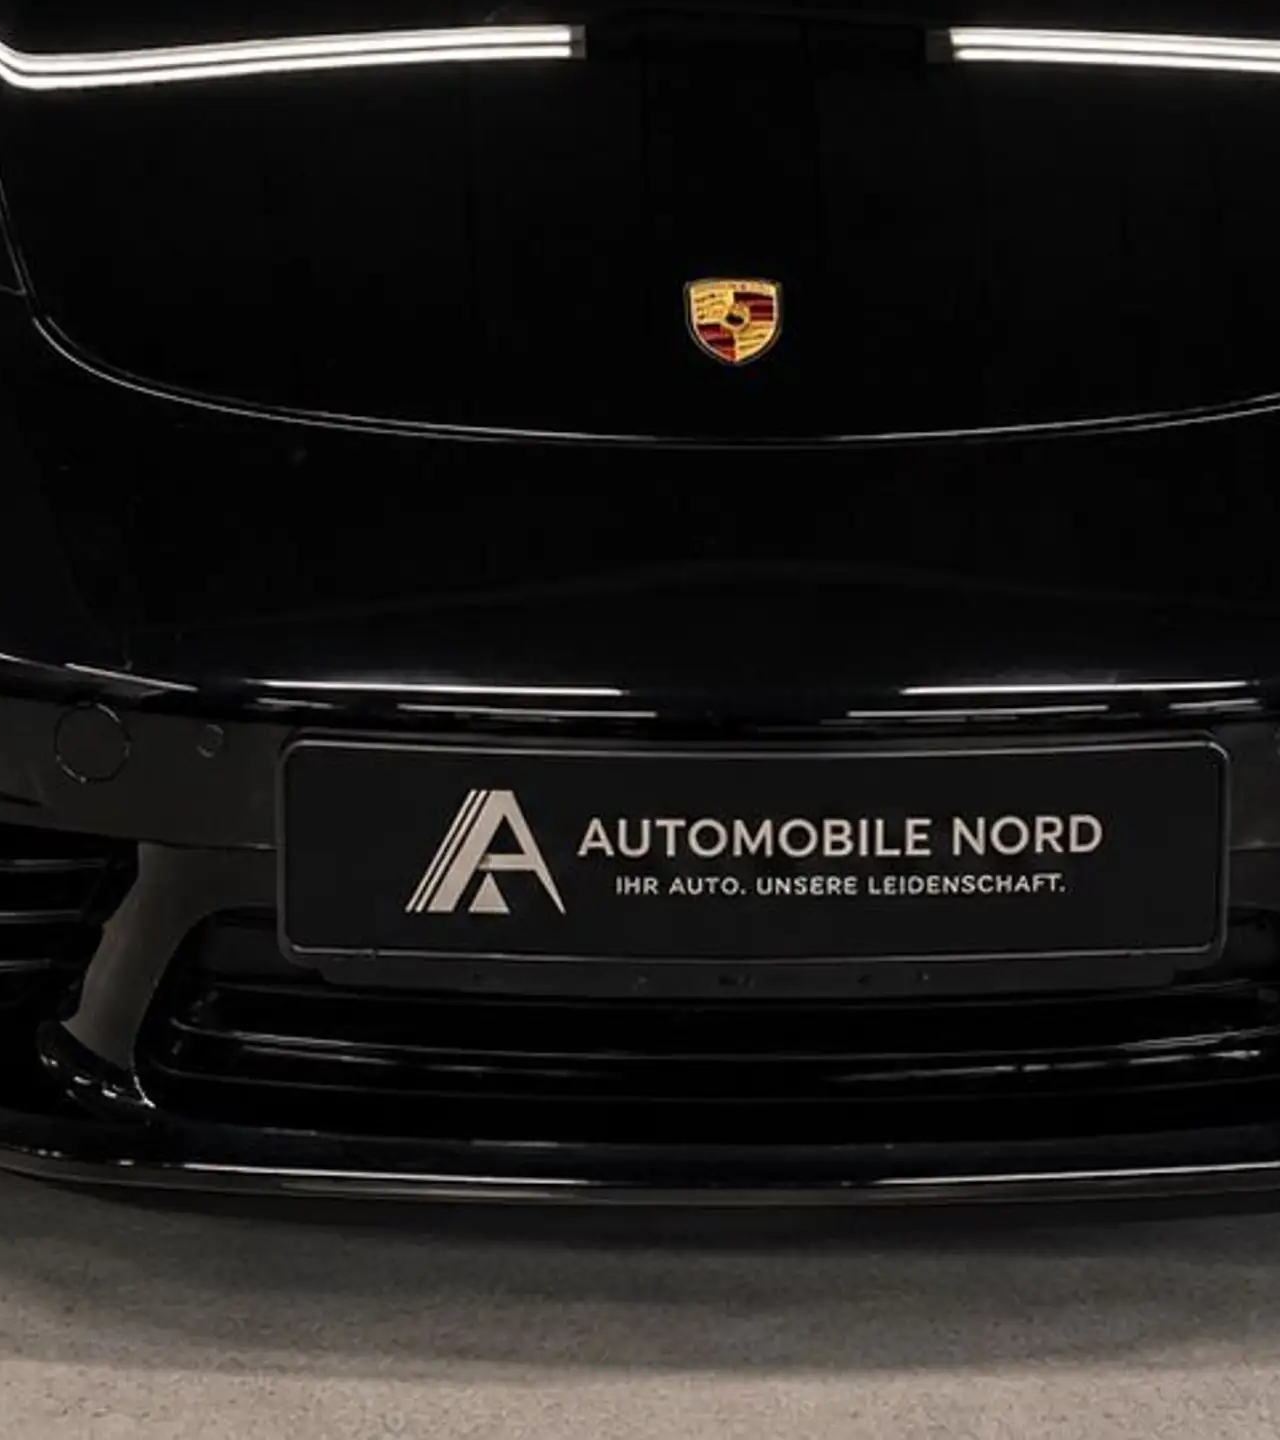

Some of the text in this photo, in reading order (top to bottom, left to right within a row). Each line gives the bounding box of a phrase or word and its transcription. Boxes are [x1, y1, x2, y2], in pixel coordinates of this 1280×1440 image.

[577, 814, 1104, 858] AUTOMOBILE NORD
[615, 872, 1066, 896] IHR AUTO. UNSERE LEIDENSCHAFT.
